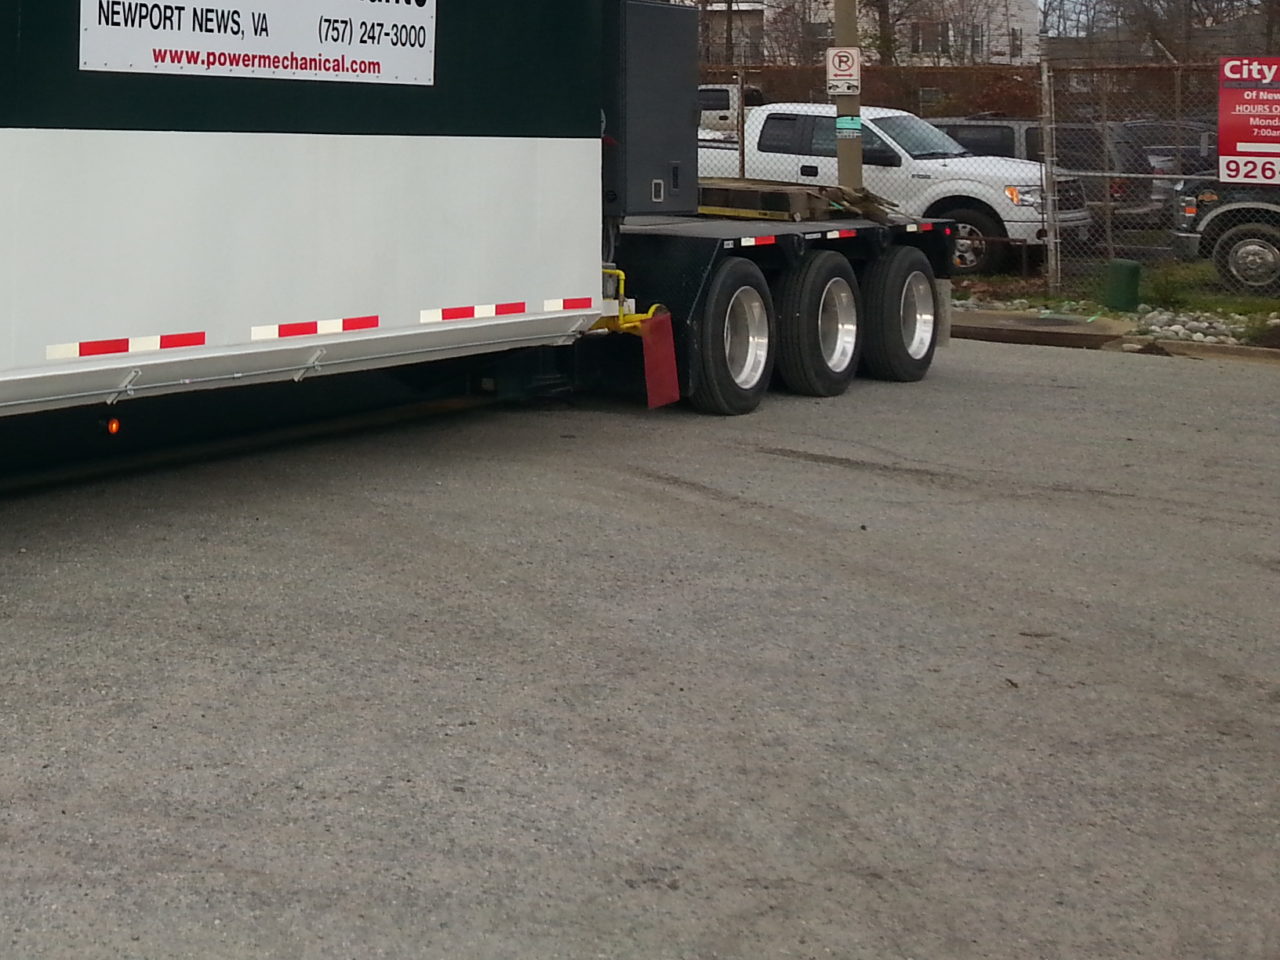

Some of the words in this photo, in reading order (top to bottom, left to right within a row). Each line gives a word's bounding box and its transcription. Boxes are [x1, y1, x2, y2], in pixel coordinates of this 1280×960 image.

[98, 0, 185, 32] NEWPORT
[192, 7, 246, 40] NEWS,
[251, 12, 269, 38] VA
[318, 15, 354, 45] (757)
[359, 21, 427, 49] 247-3000
[152, 47, 382, 75] www.powermechanical.com
[1224, 60, 1278, 84] City
[1244, 91, 1257, 100] Of
[1236, 104, 1270, 113] HOURS
[1250, 117, 1280, 126] Mond
[1226, 159, 1280, 180] 926
